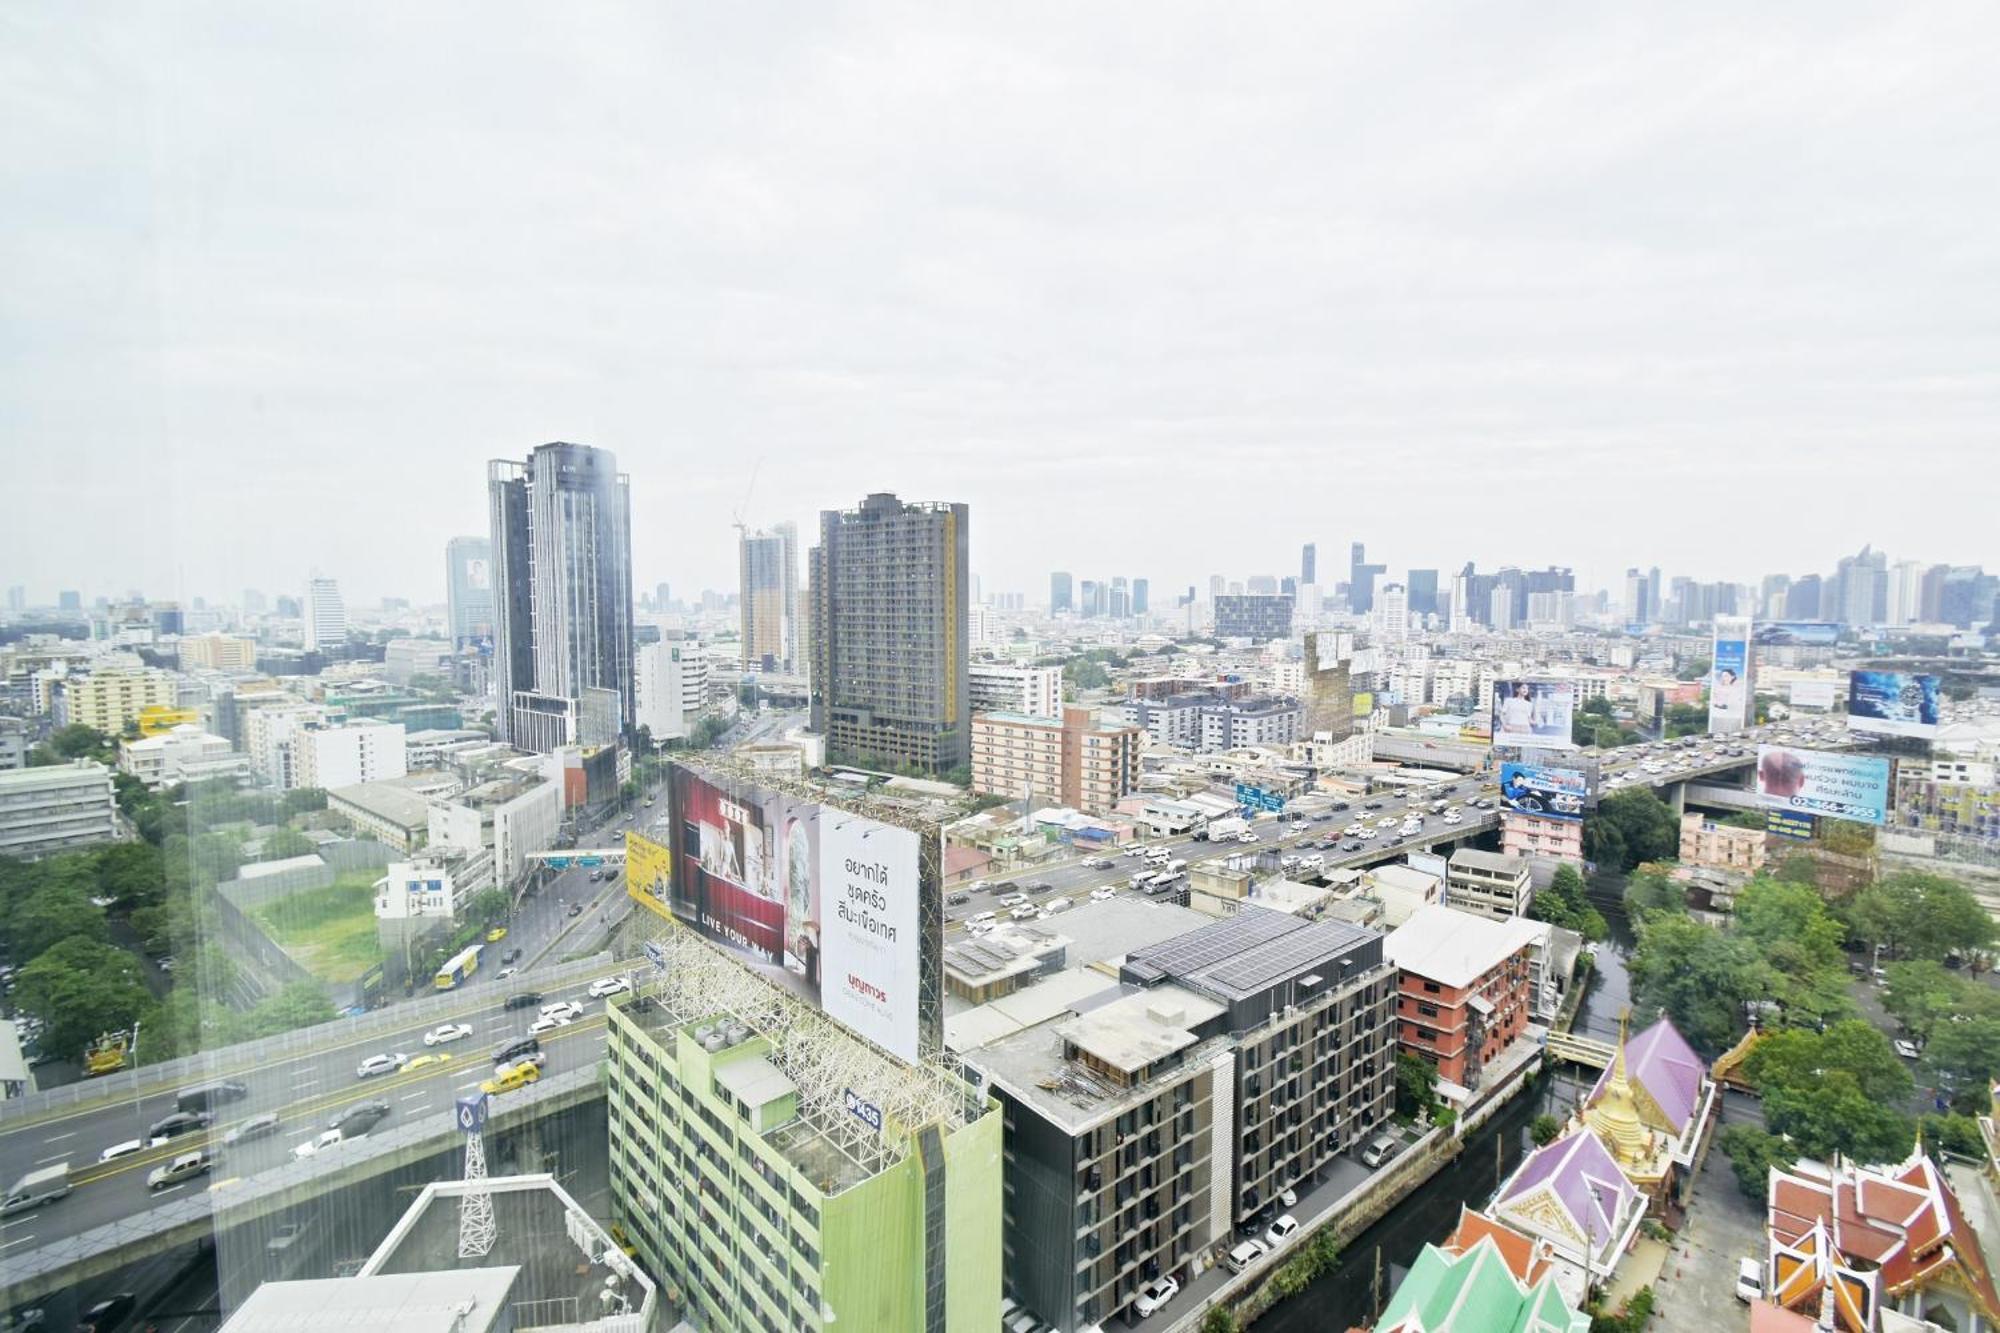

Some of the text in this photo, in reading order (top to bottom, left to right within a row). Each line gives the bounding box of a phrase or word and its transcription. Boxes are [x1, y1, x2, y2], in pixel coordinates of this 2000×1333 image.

[845, 858, 888, 886] อยากได้
[847, 883, 887, 911] ชุดครัว
[701, 912, 721, 933] LIVE
[723, 926, 748, 948] YOUR
[838, 900, 897, 943] สีมะเขือเทศ
